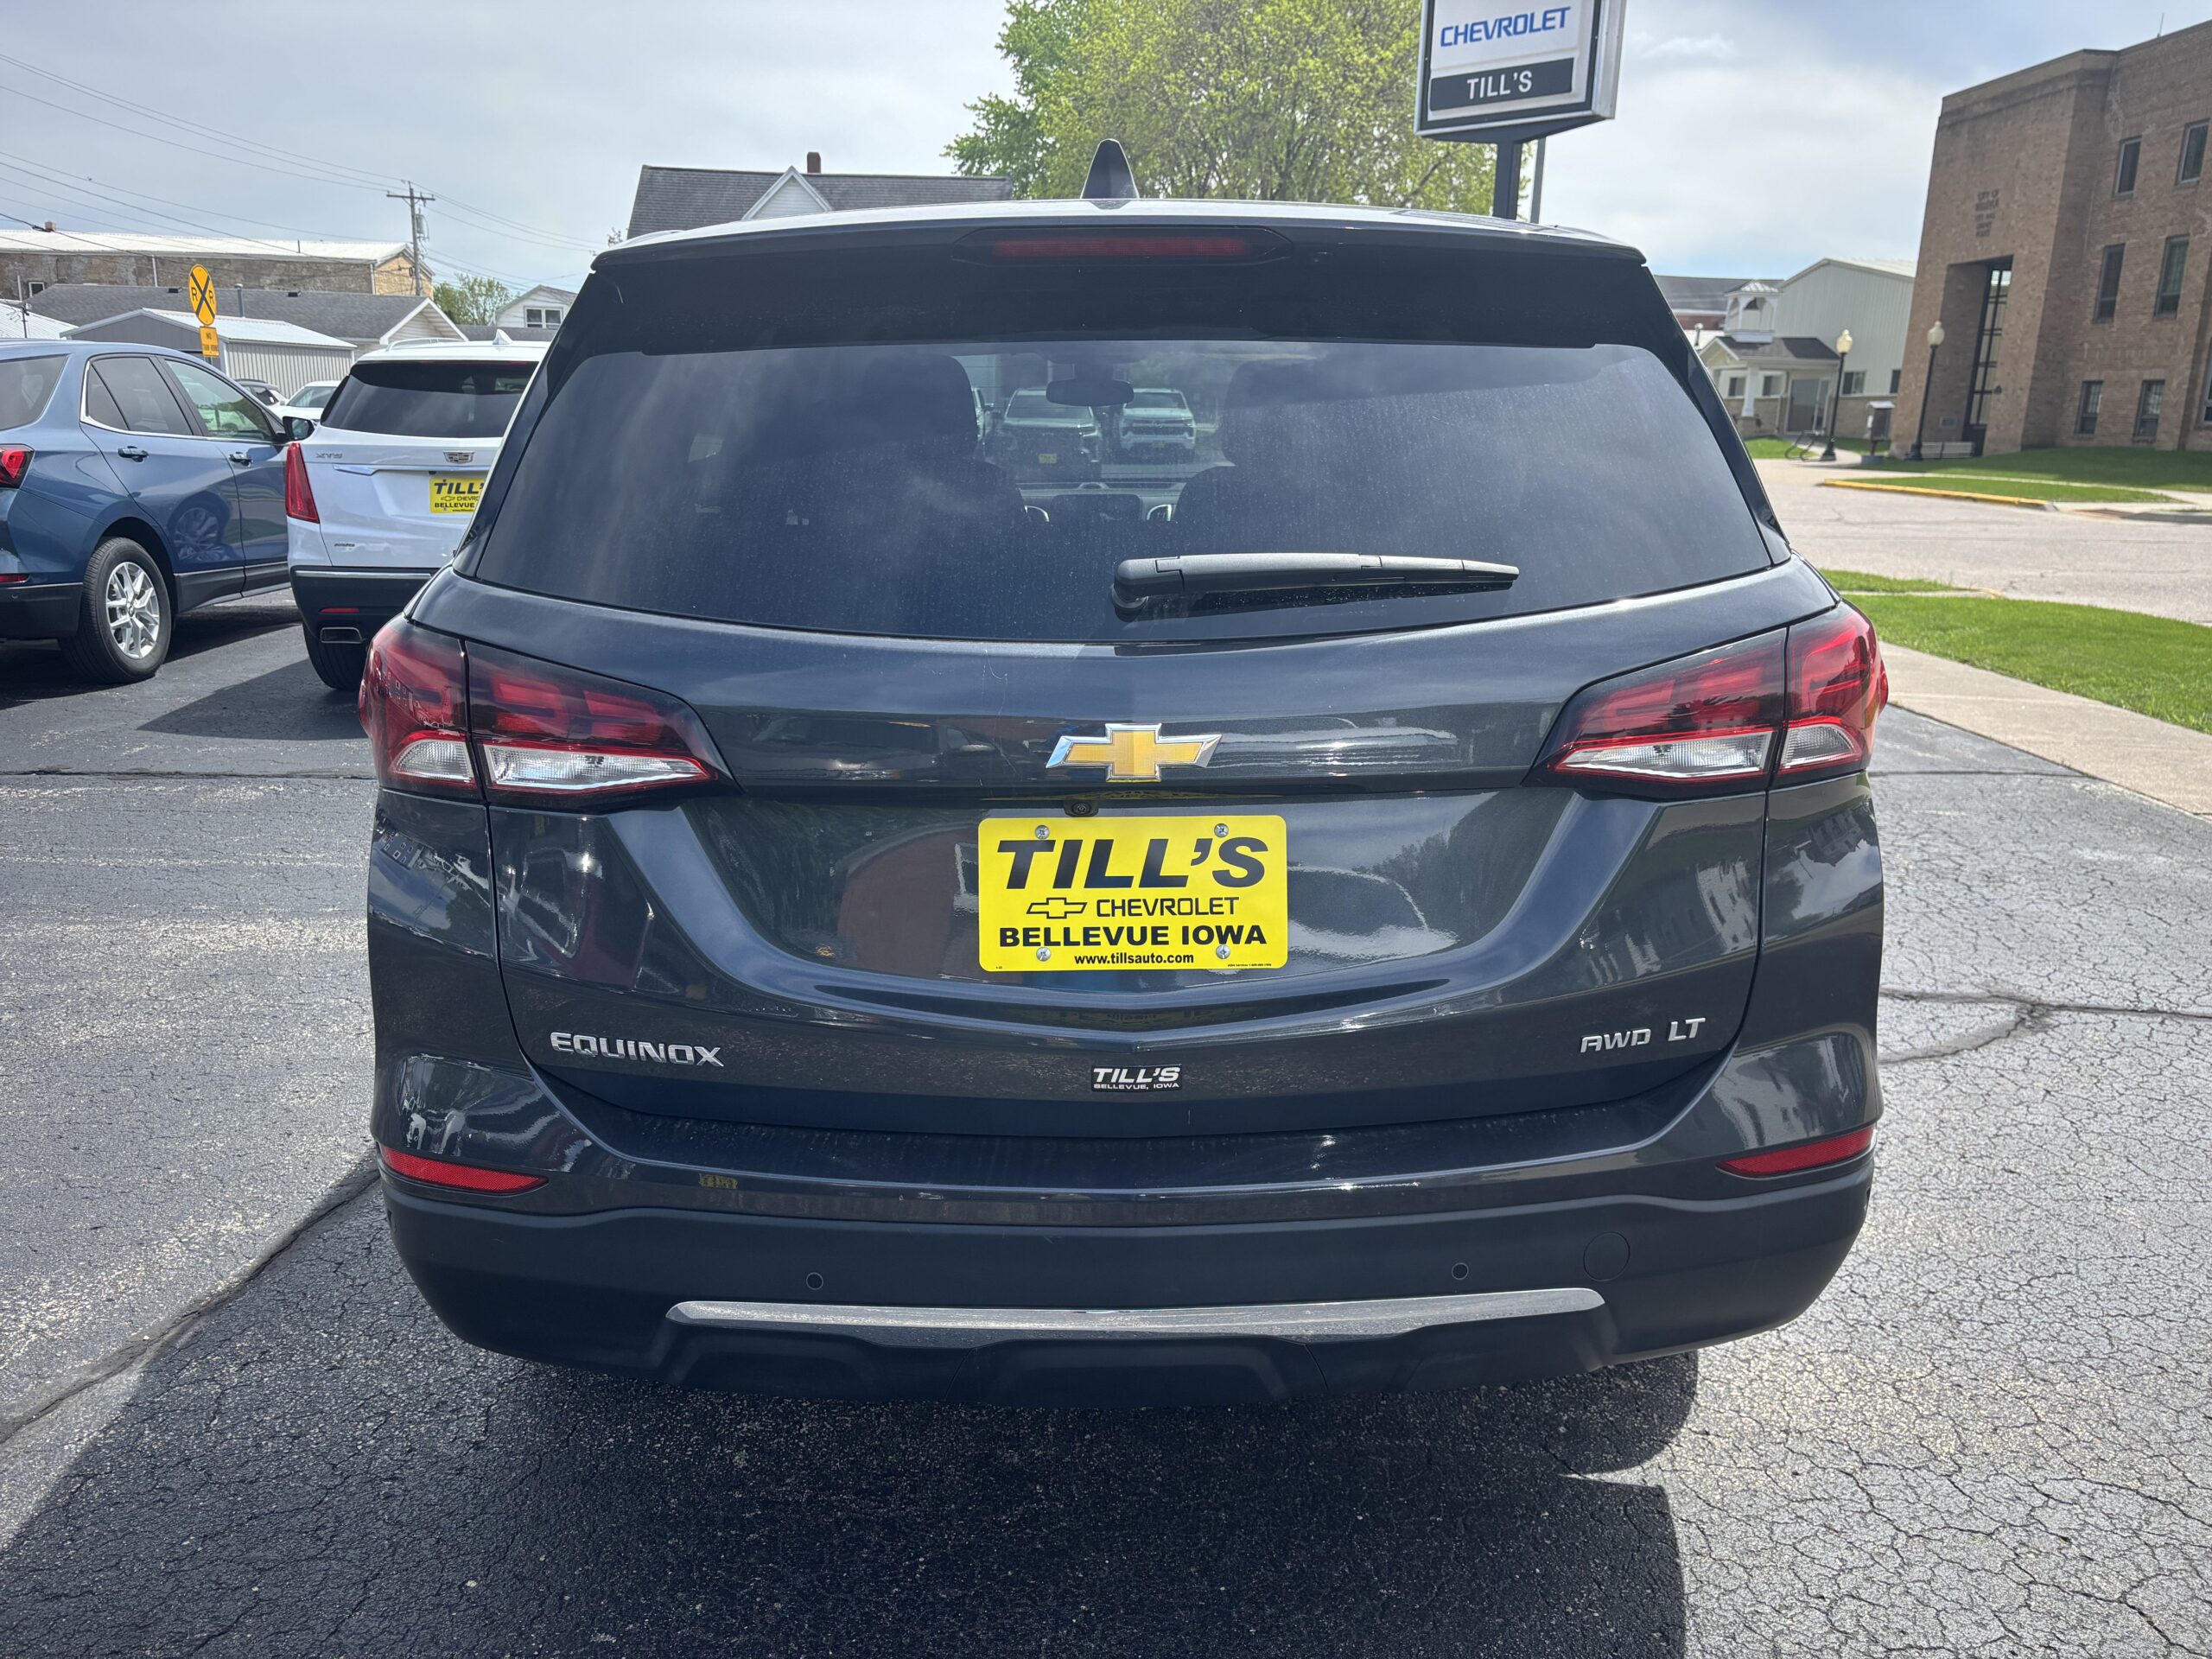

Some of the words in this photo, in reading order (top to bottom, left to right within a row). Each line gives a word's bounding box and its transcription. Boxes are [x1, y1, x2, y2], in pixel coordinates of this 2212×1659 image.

[1440, 7, 1571, 47] CHEVROLET
[1467, 70, 1533, 99] TILL'S
[191, 287, 199, 302] R
[208, 289, 215, 304] R
[434, 482, 485, 495] TILL'
[997, 836, 1268, 889] TILL'S
[1096, 896, 1240, 917] CHEVROLET
[999, 925, 1169, 947] BELLEVUE
[1181, 925, 1268, 945] IOWA
[1074, 952, 1195, 964] www.tillsauto.com
[1580, 1028, 1651, 1053] AWD
[1668, 1017, 1707, 1042] LT
[550, 1032, 724, 1067] EQUINOX
[1093, 1066, 1181, 1084] TILL'S
